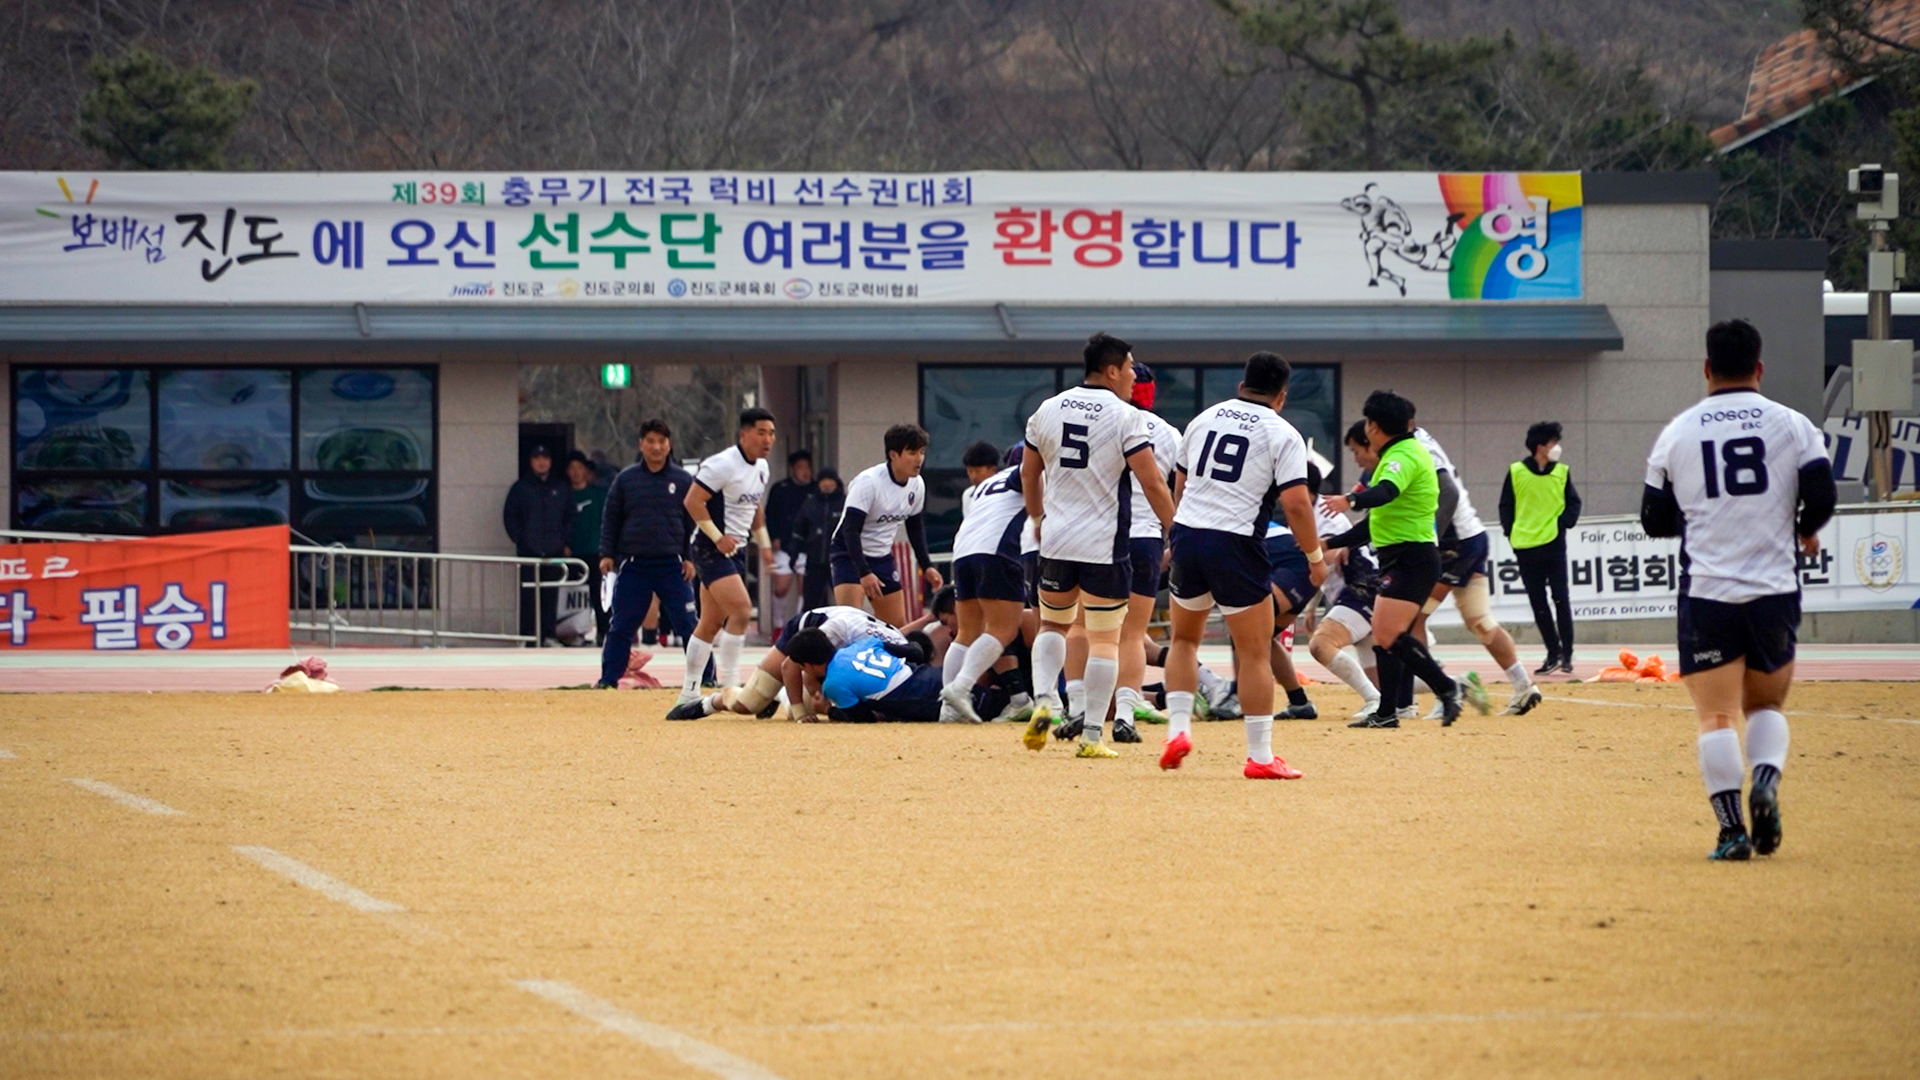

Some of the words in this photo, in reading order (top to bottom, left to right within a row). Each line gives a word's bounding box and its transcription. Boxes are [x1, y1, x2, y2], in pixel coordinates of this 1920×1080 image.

[391, 181, 485, 206] 제39회
[501, 176, 607, 207] 충무기
[625, 177, 693, 206] 전국
[709, 177, 775, 206] 럭비
[794, 177, 972, 207] 선수권대회
[63, 213, 166, 264] 보배섬
[175, 207, 299, 282] 진도
[312, 219, 365, 270] 에
[386, 219, 496, 270] 오신
[518, 212, 722, 271] 선수단
[743, 219, 970, 271] 여러분을
[993, 206, 1302, 269] 환영합니다
[502, 281, 544, 297] 진도군
[584, 281, 655, 297] 진도군의회
[690, 281, 775, 297] 진도군체육회
[818, 282, 919, 298] 진도군럭비협회
[1061, 399, 1103, 413] posco
[1215, 408, 1260, 423] posco
[1701, 408, 1763, 426] posco
[1060, 422, 1089, 469] 5
[1196, 430, 1250, 483] 19
[1701, 436, 1769, 499] 18
[1580, 530, 1610, 544] Fair,
[80, 583, 227, 650] 필승!
[851, 648, 892, 679] 12
